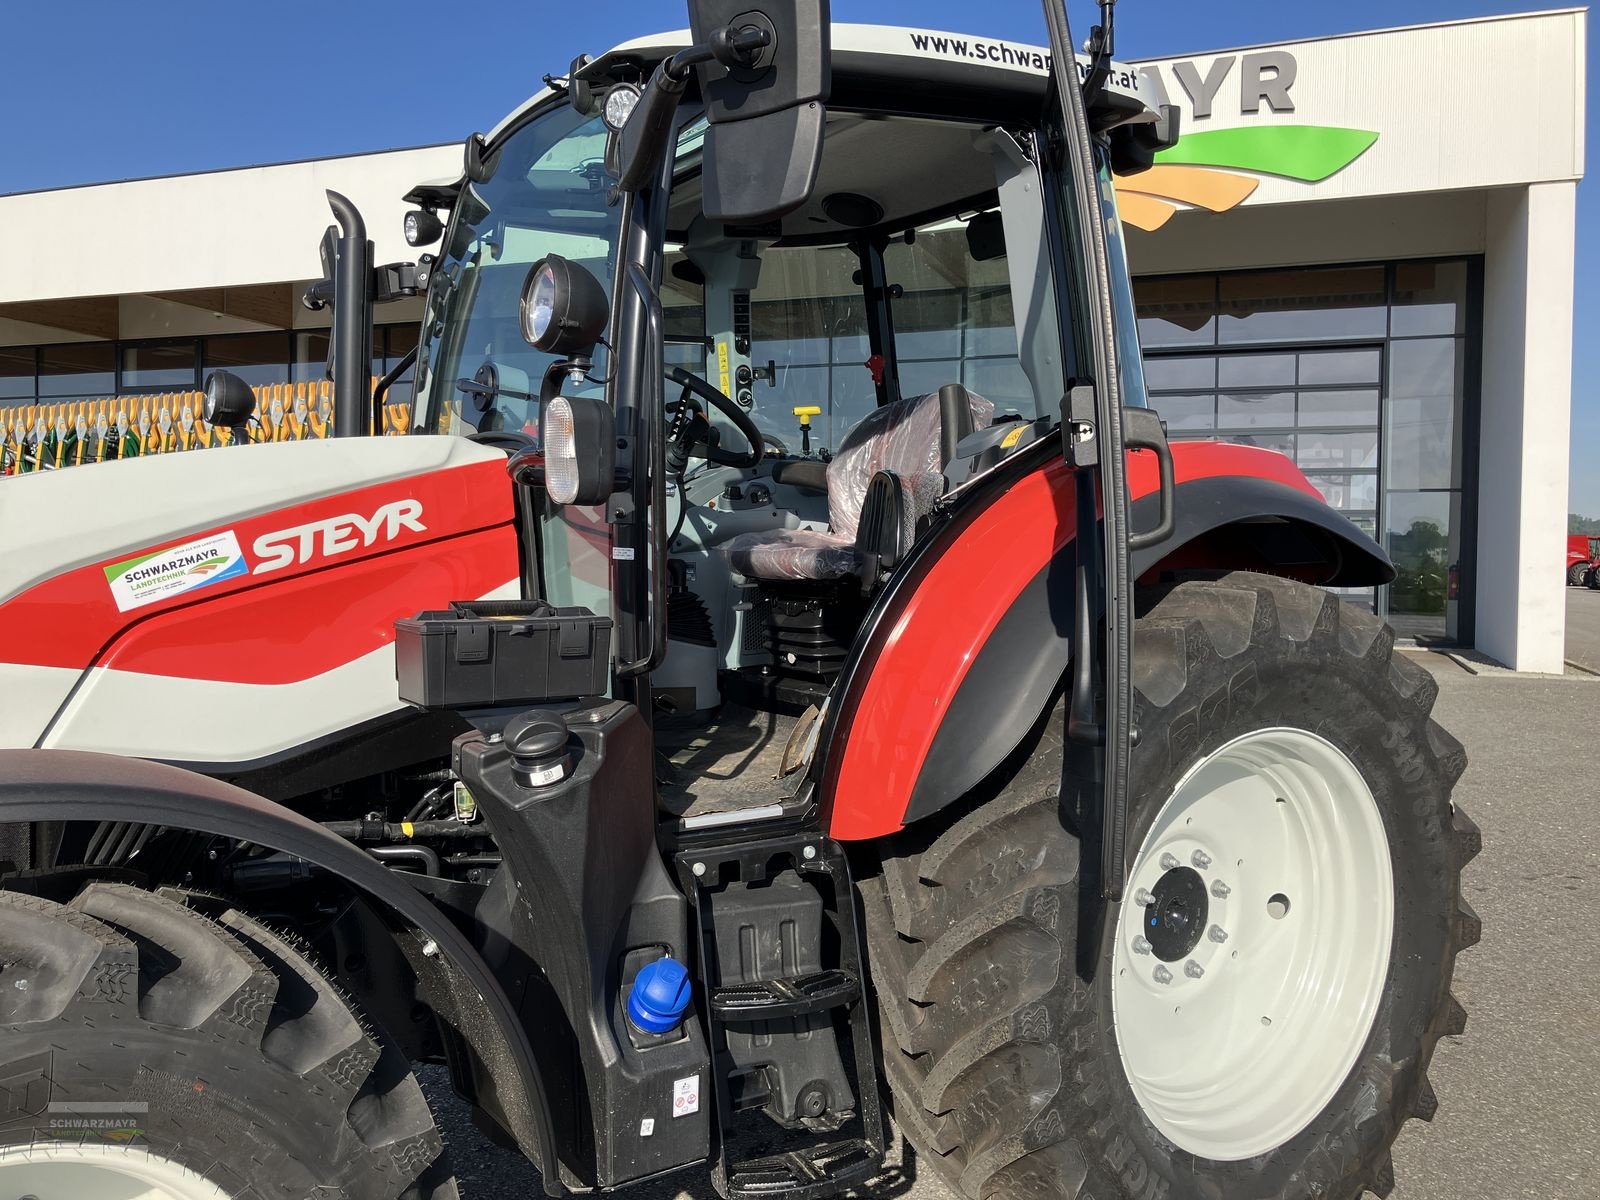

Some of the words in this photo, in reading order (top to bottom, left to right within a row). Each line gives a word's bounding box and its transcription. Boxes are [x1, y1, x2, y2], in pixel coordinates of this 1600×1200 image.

[252, 499, 428, 575] STEYR
[125, 548, 219, 583] SCHWARZMAYR
[130, 569, 187, 591] LANDTECHNIK
